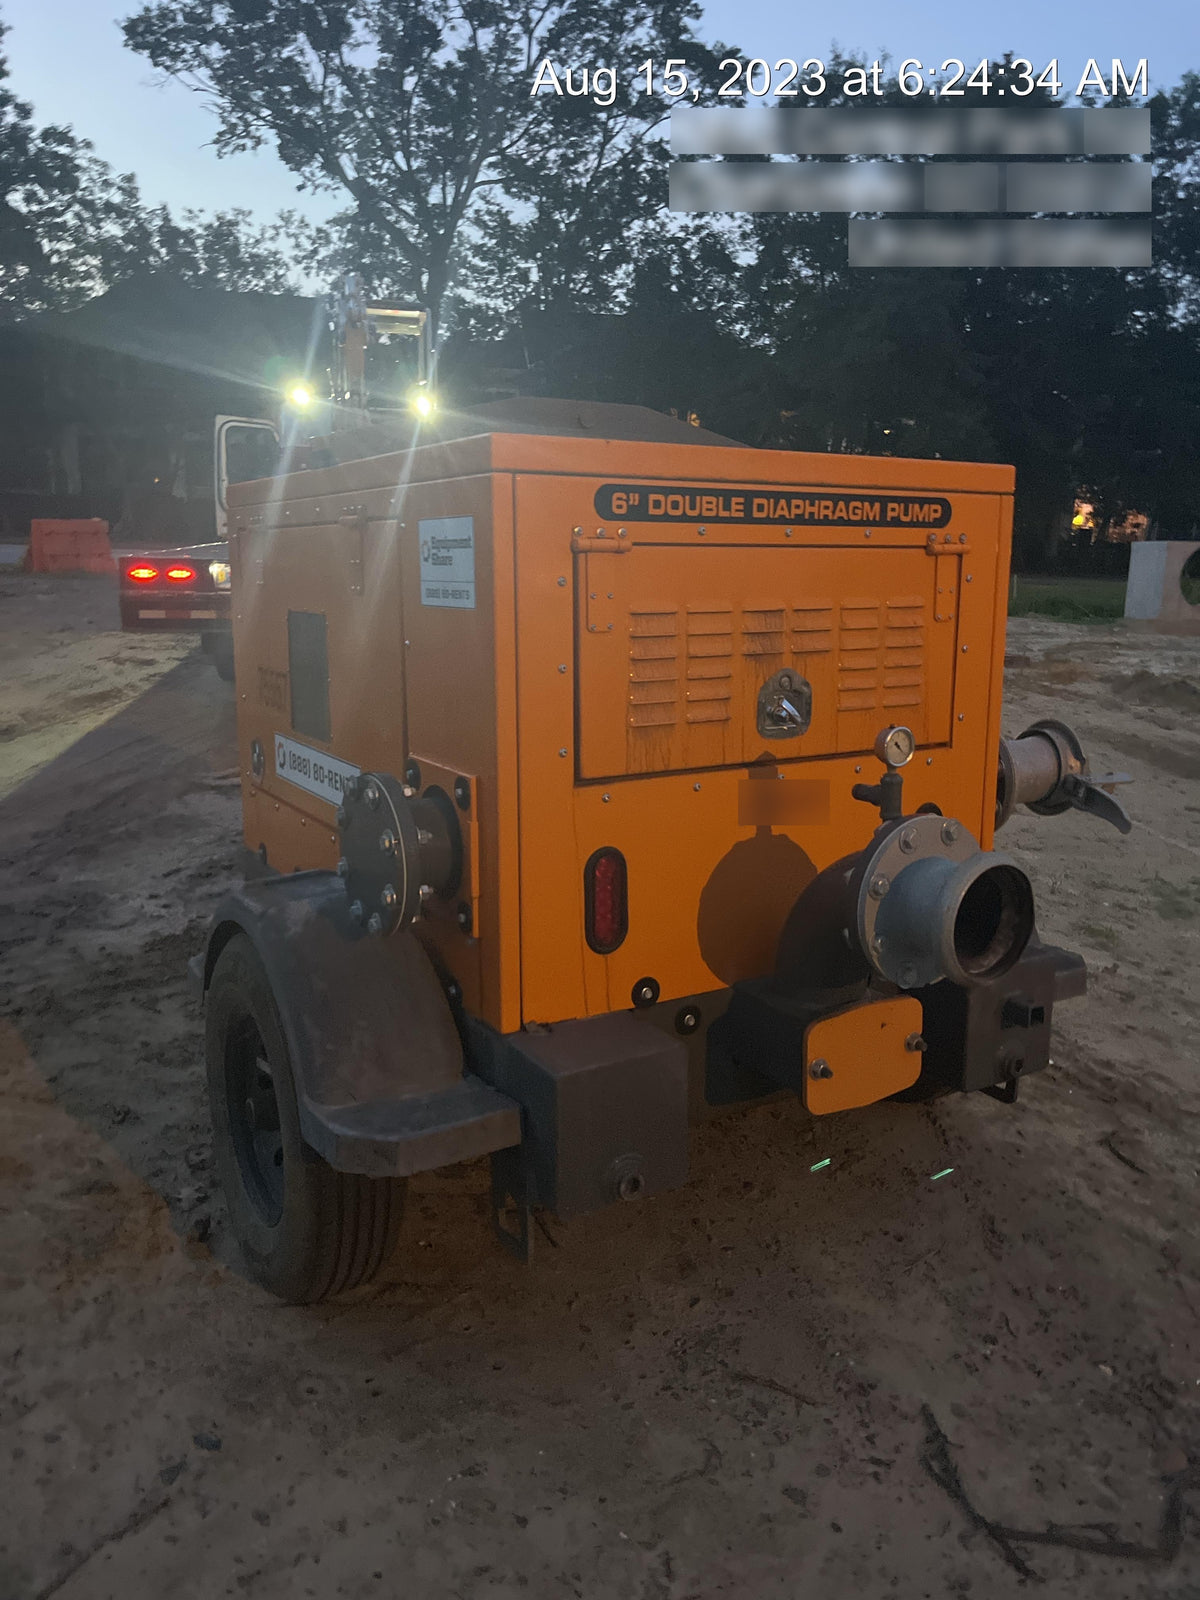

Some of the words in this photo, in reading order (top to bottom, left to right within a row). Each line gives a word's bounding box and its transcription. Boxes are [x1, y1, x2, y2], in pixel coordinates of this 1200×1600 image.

[648, 494, 745, 518] DOUBLE
[752, 498, 880, 521] DIAPHRAGM
[887, 502, 942, 523] PUMP
[289, 750, 310, 778] (888)
